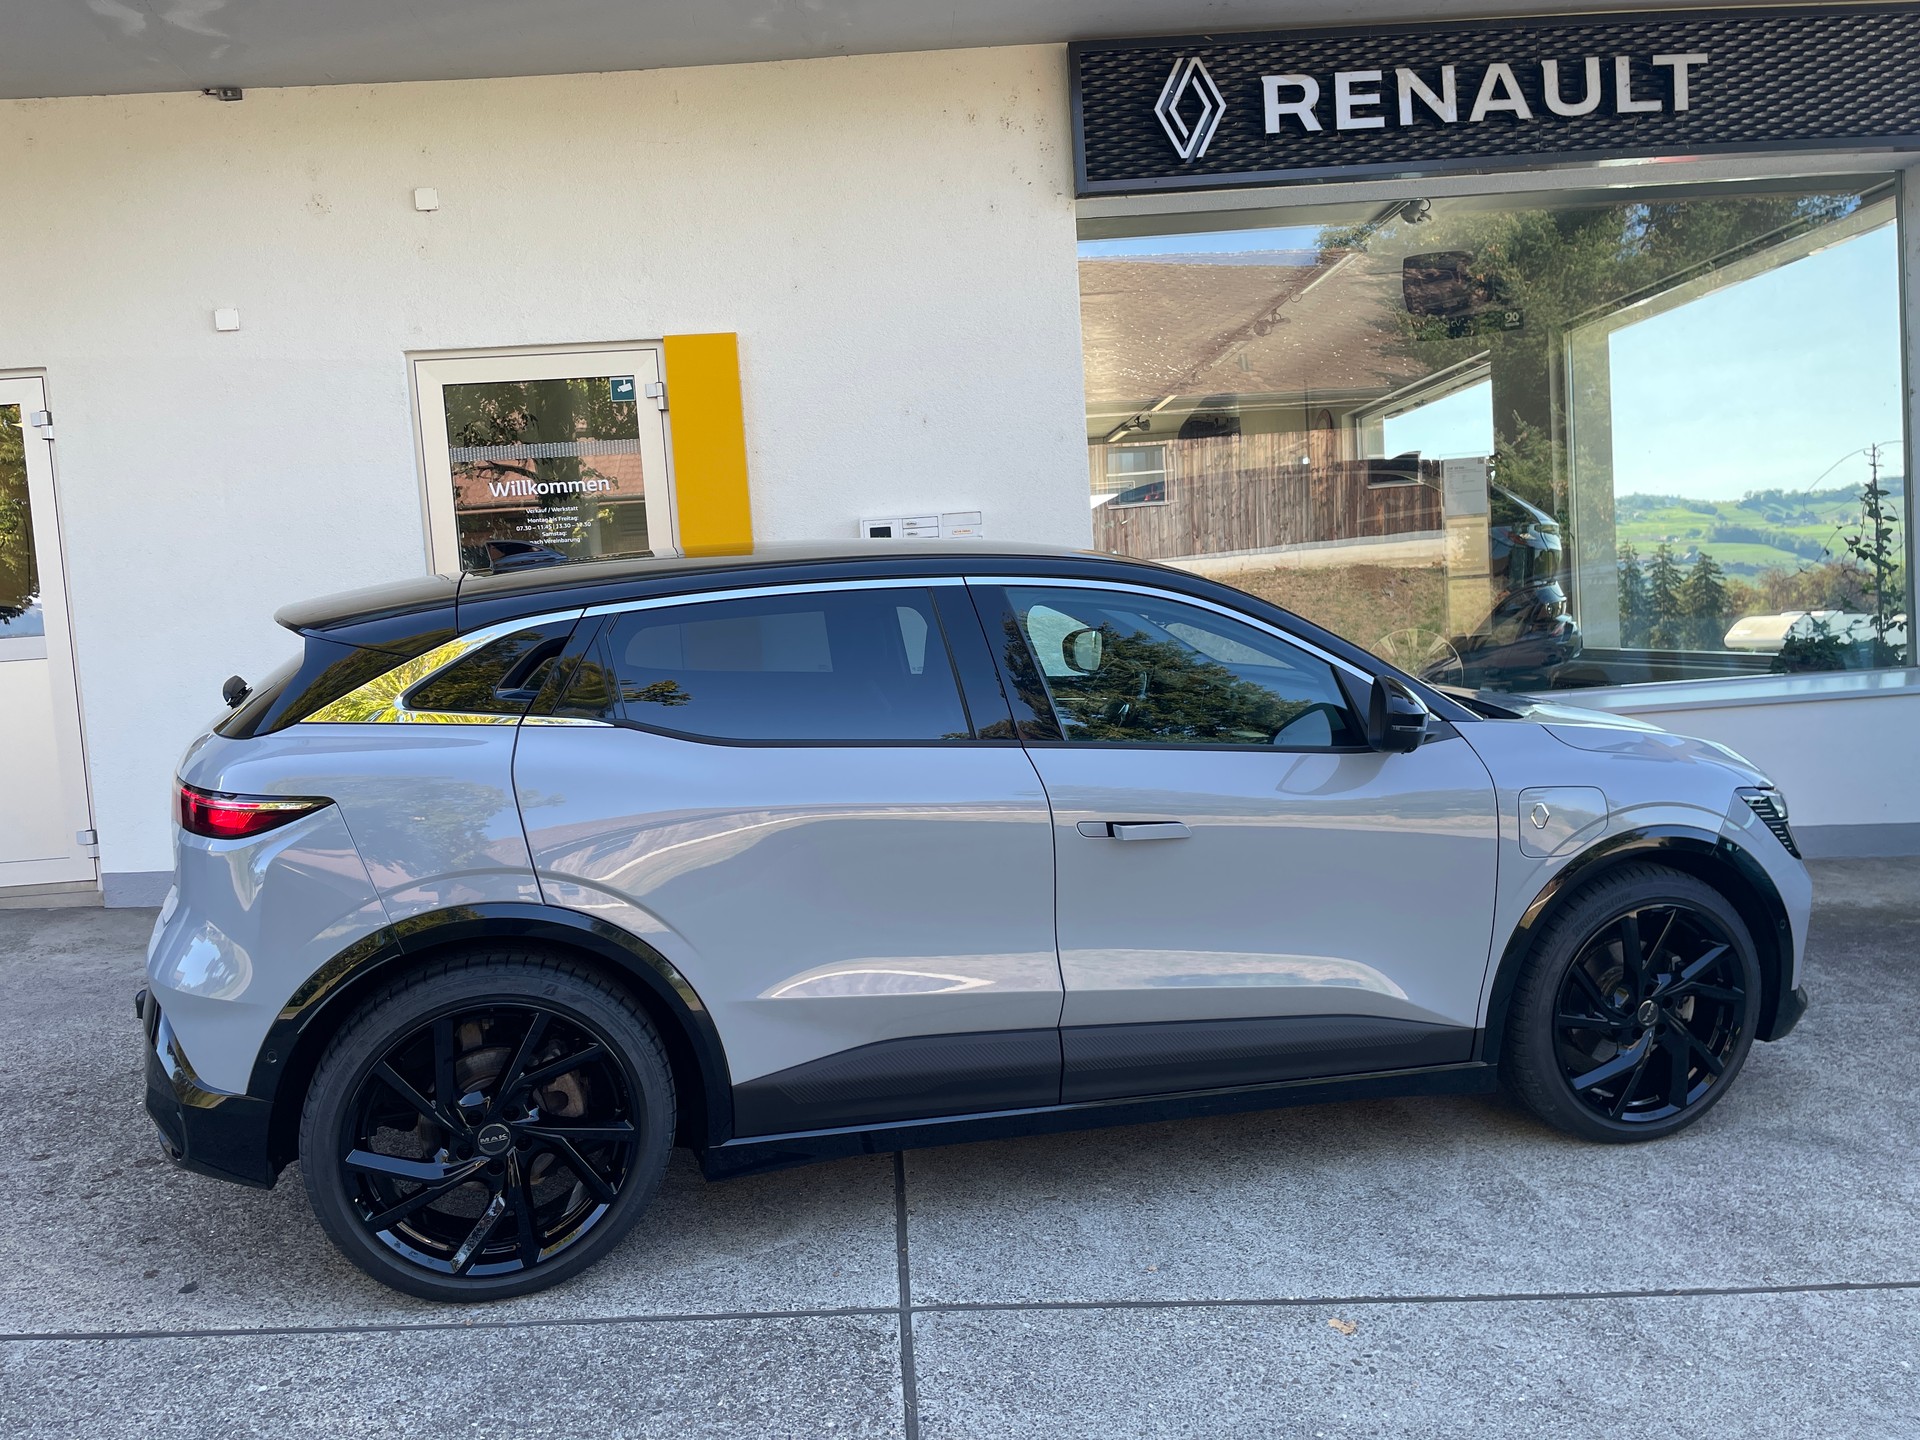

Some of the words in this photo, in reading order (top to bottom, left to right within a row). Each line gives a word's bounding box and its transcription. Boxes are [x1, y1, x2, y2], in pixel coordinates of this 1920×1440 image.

[1261, 53, 1708, 134] RENAULT
[489, 479, 610, 498] Willkommen
[480, 1133, 508, 1144] MAK
